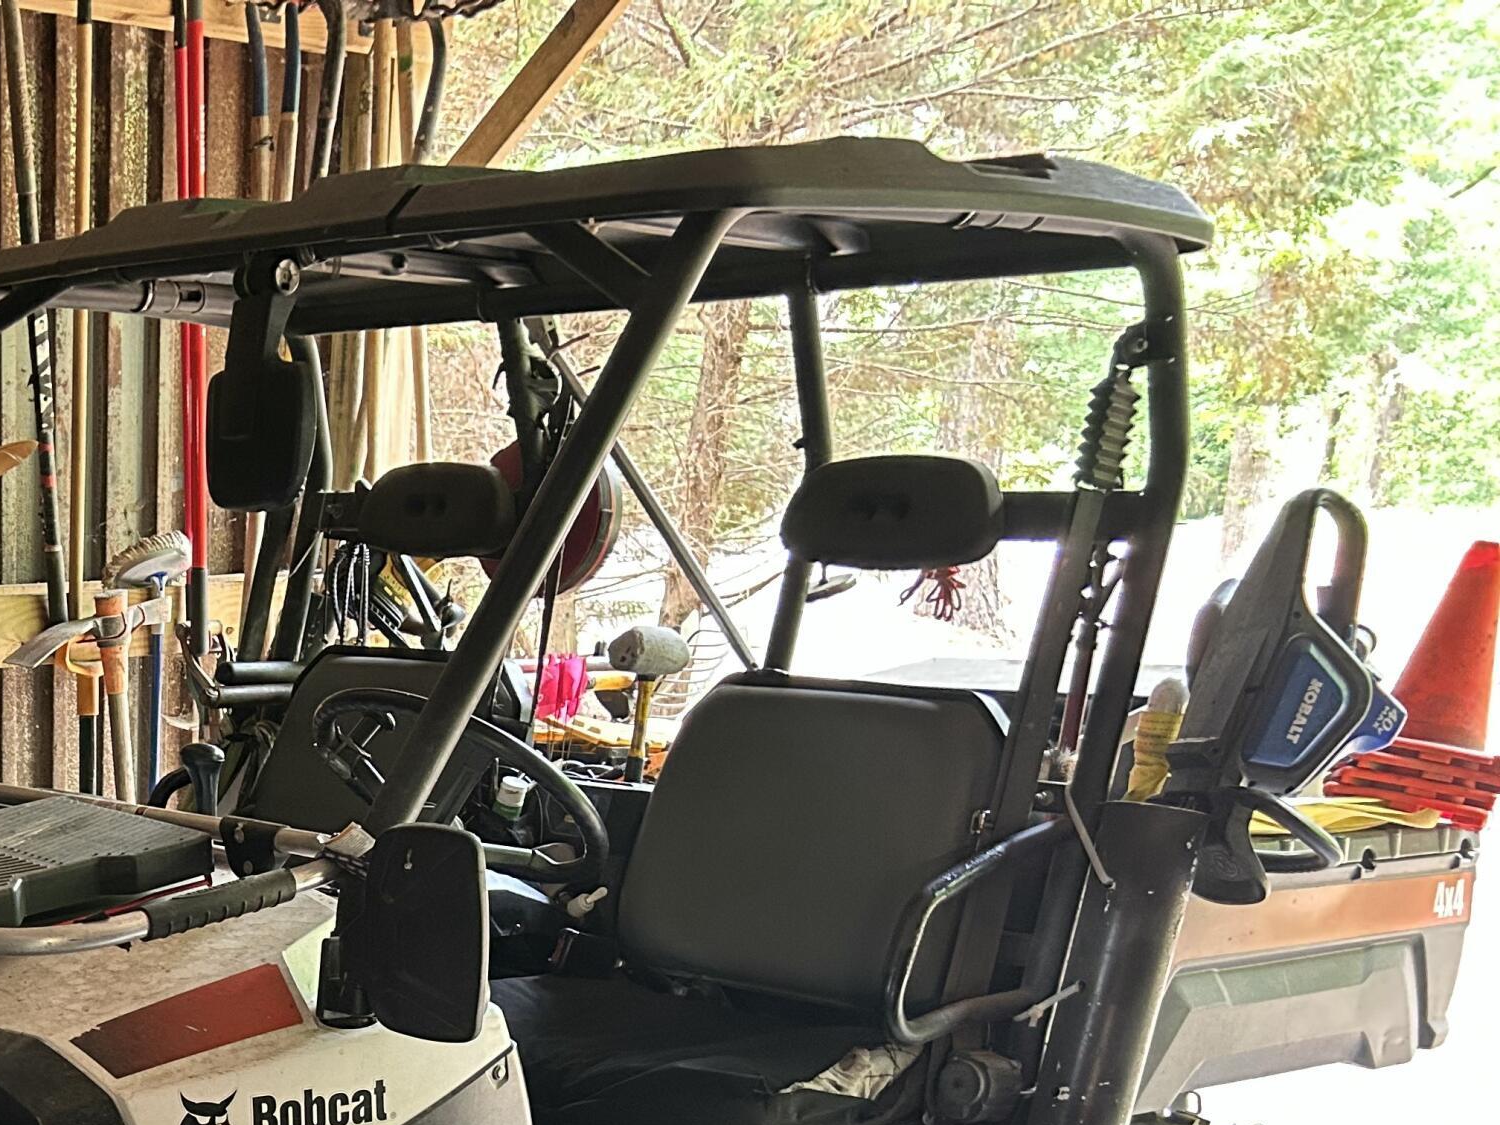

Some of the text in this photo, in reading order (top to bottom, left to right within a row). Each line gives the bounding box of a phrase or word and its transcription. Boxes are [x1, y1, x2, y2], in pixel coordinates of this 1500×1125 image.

[1286, 678, 1324, 745] KOBALT
[1372, 705, 1390, 729] MAX
[1432, 878, 1466, 919] 4x4
